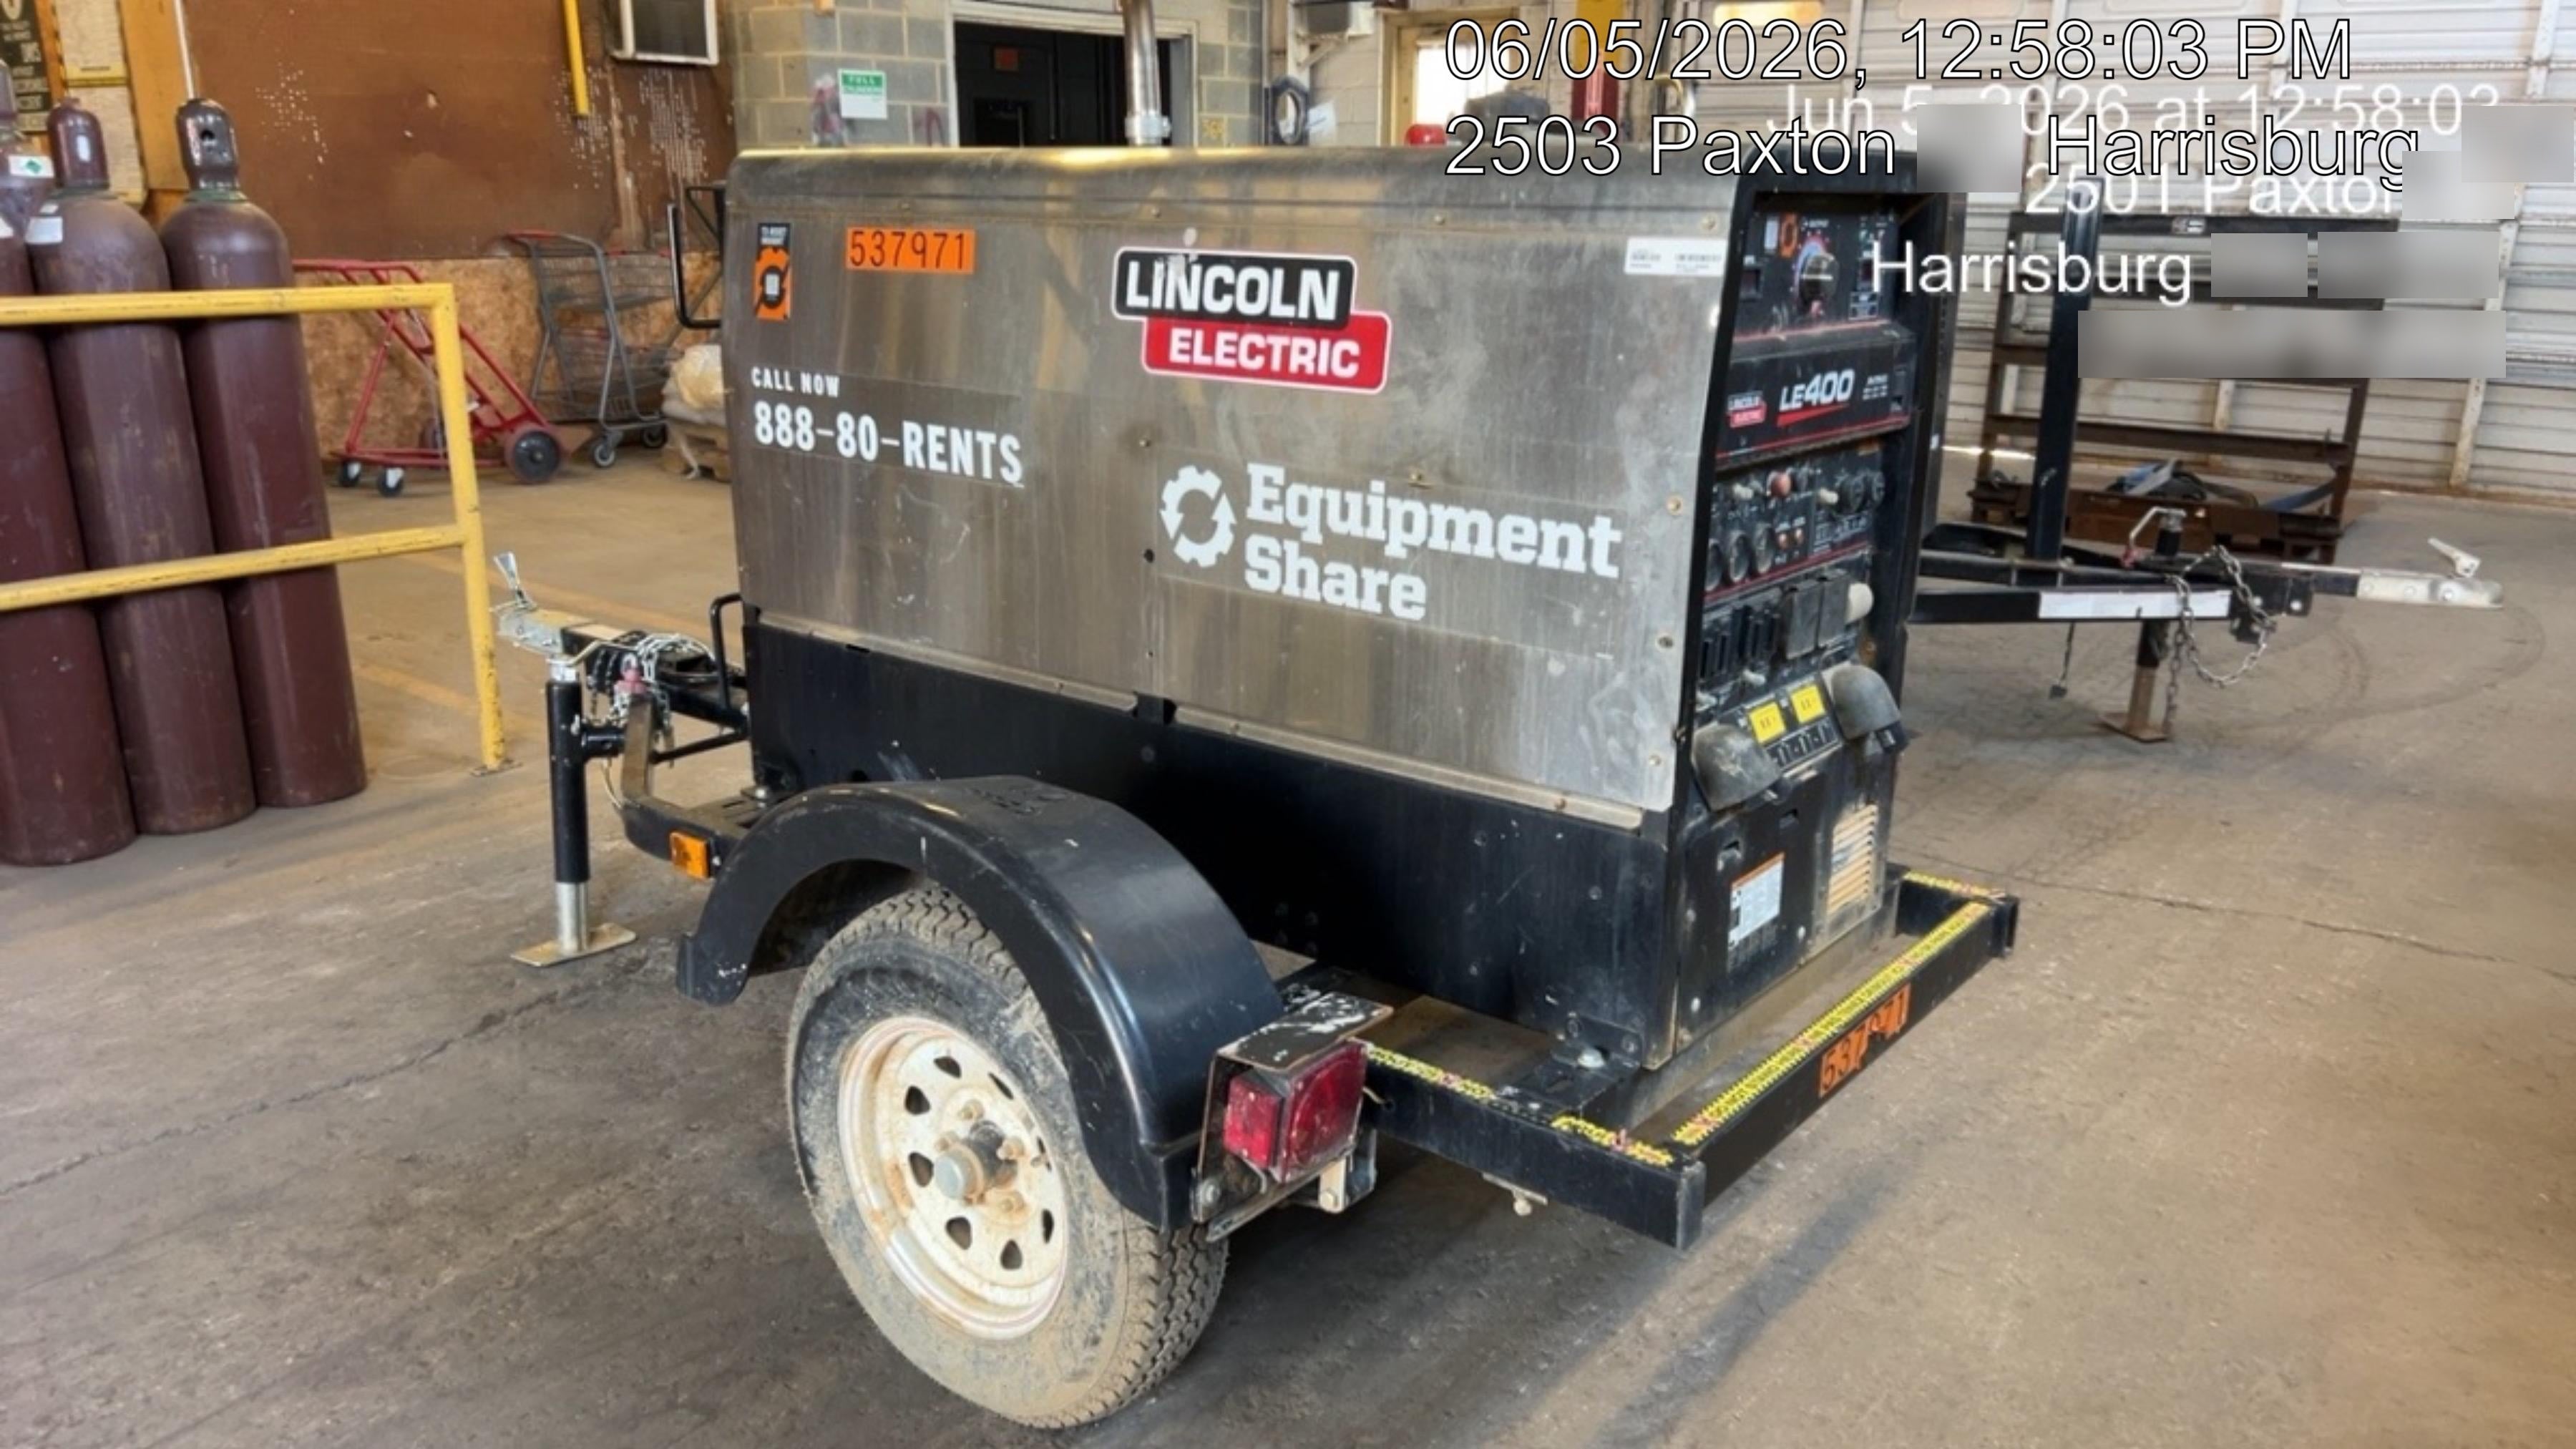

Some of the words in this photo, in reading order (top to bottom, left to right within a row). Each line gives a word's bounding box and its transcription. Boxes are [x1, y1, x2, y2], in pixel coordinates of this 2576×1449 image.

[849, 230, 965, 269] 537971
[1125, 260, 1340, 321] LINCOLN
[1169, 327, 1360, 378] ELECTRIC
[751, 366, 794, 392] CALL
[800, 371, 840, 398] NOW
[1779, 369, 1855, 412] LE400
[754, 400, 1024, 486] 888-80-RENTS
[1246, 462, 1623, 578] Equipment
[1244, 534, 1427, 620] Share
